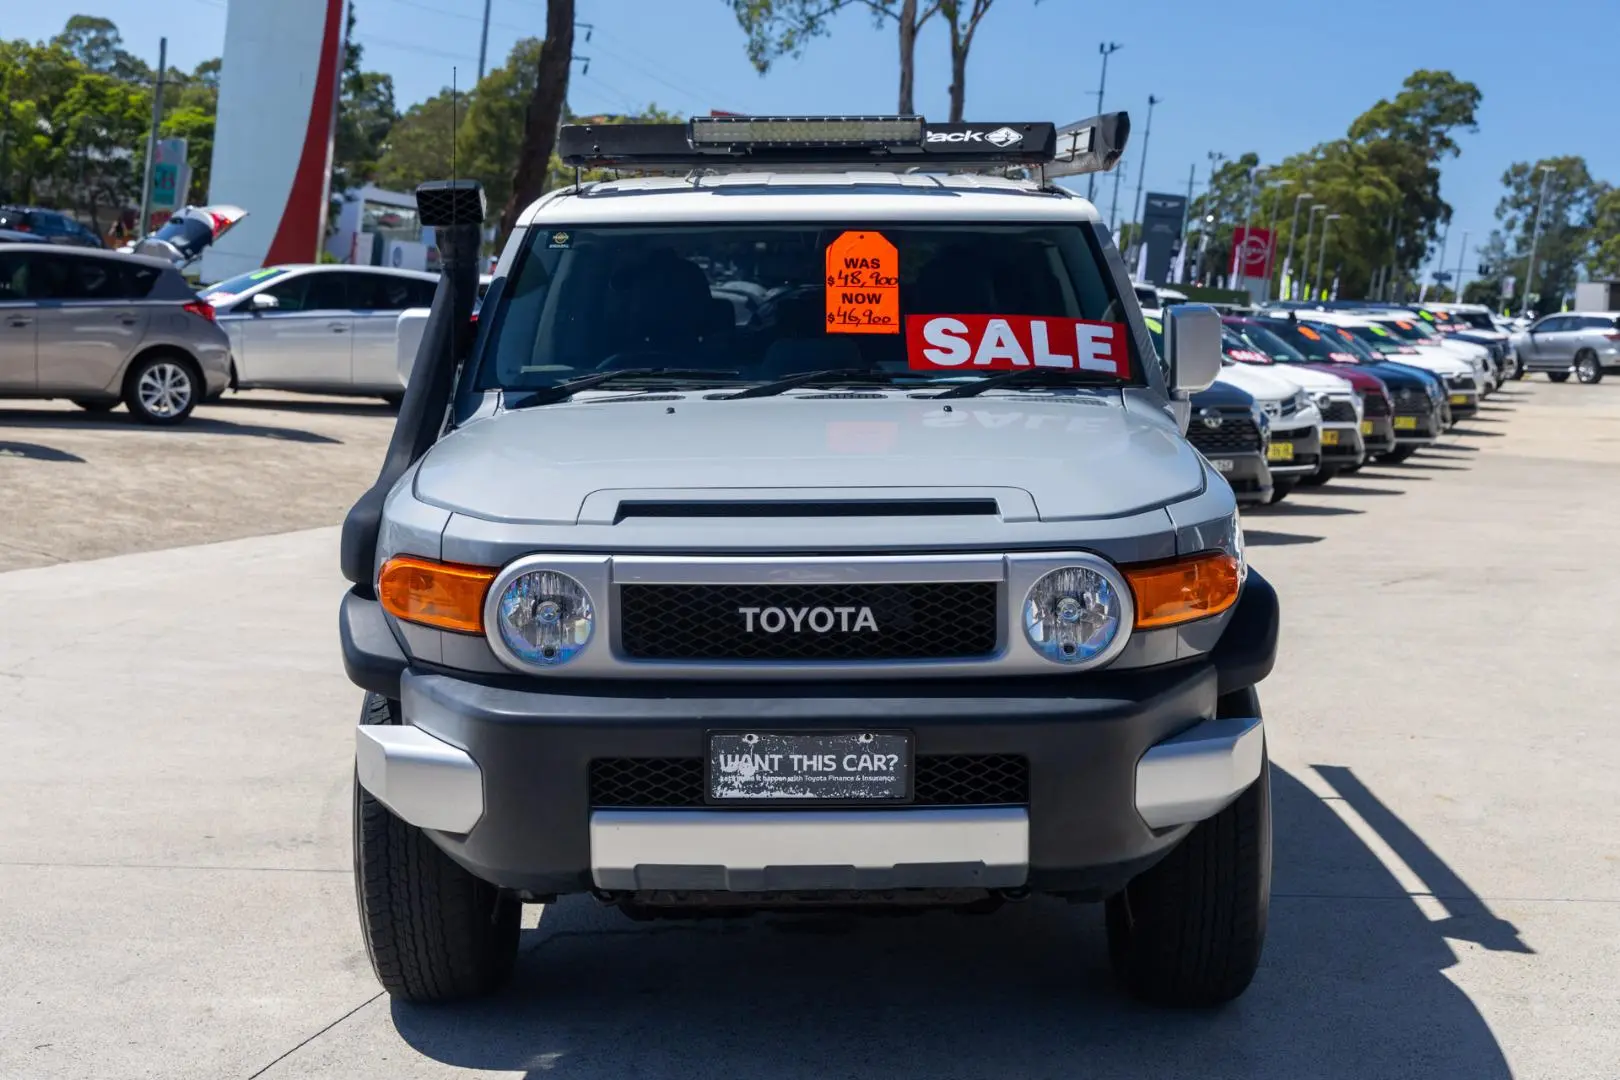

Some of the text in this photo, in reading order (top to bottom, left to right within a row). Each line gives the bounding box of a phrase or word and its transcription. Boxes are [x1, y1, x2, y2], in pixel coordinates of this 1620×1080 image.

[844, 258, 881, 269] WAS
[841, 293, 882, 304] NOW
[923, 317, 1118, 372] SALE
[738, 606, 879, 633] TOYOTA
[719, 755, 899, 772] WANT THIS CAR?
[805, 775, 827, 783] Toyota
